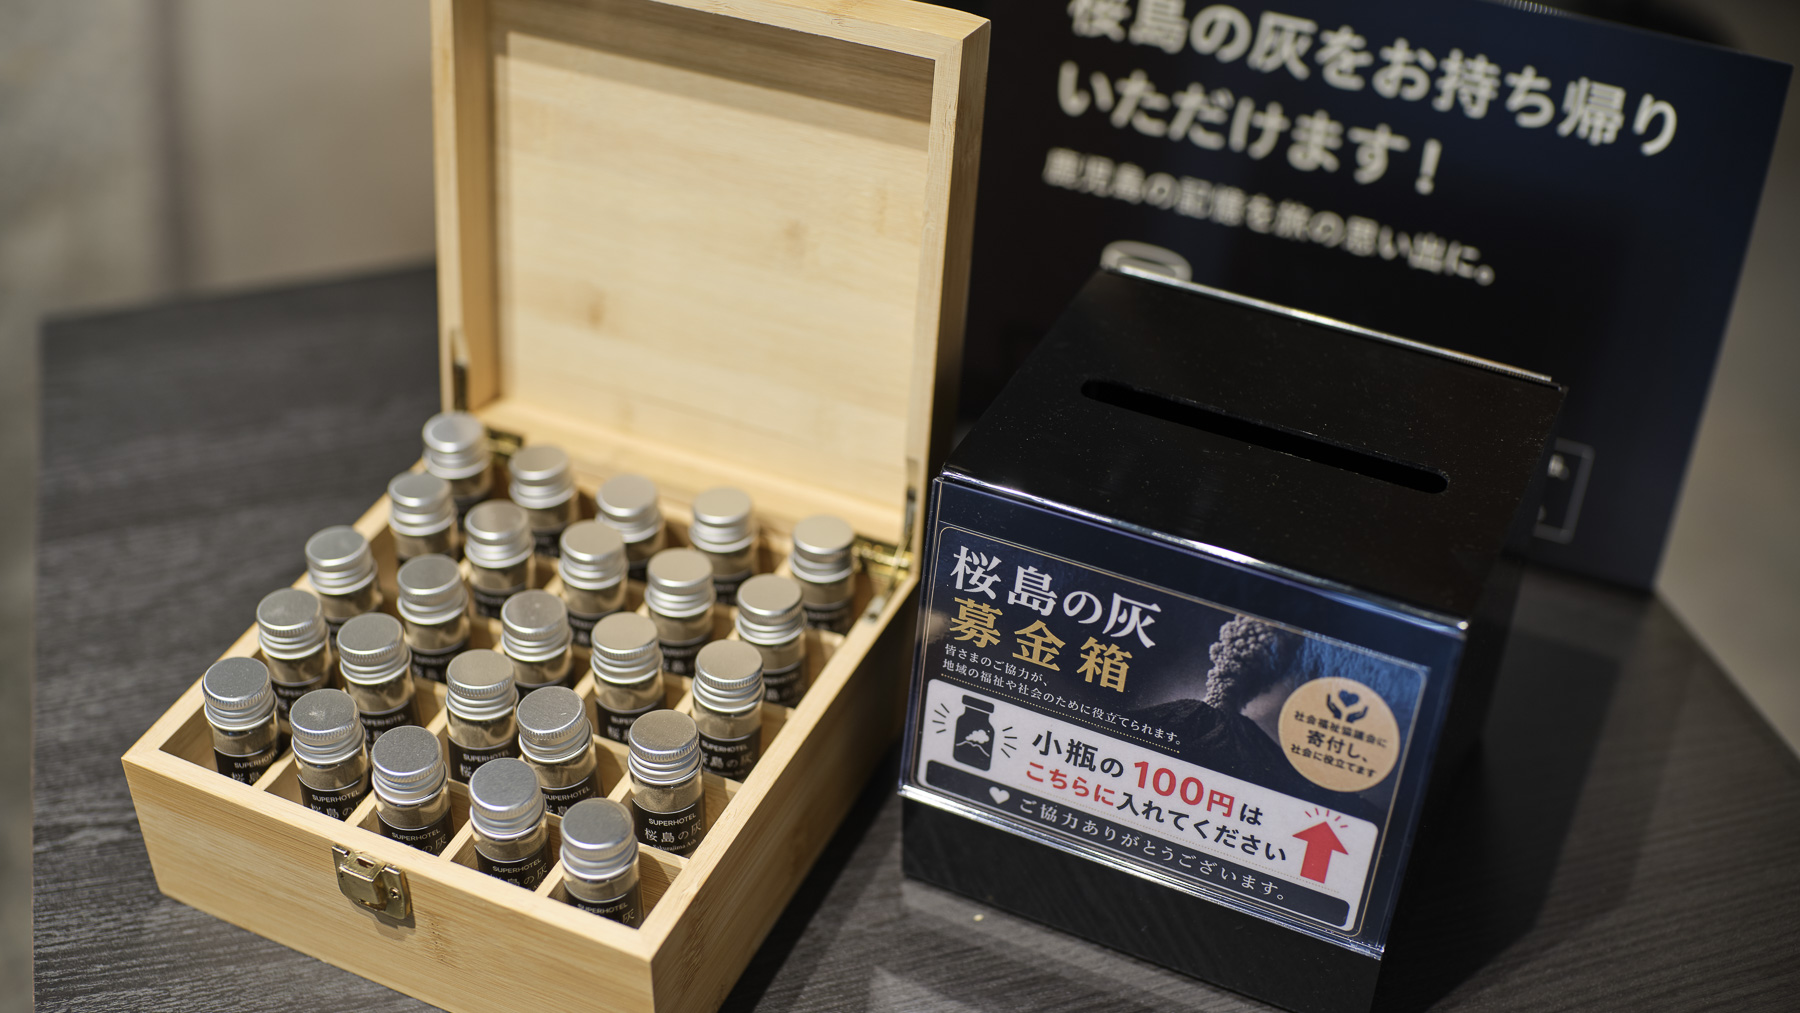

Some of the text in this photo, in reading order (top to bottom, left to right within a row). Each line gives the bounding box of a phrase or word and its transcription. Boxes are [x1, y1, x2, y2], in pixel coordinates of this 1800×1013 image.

[1067, 0, 1677, 156] 桜島の灰をお持ち帰り
[950, 545, 1162, 649] 桜島の灰
[949, 596, 1133, 693] 募金箱
[945, 643, 1049, 687] 皆さまのご協力が、
[942, 658, 1181, 746] 地域の福祉や社会のために役立てられます。
[1294, 710, 1388, 748] 社会福祉協議会に
[1307, 729, 1368, 763] 寄付し、
[1290, 743, 1377, 778] 社会に役立てます
[311, 790, 361, 804] SUPERHOTEL
[1025, 760, 1288, 865] こちらに入れてください
[391, 828, 441, 842] SUPERHOTEL
[644, 819, 702, 844] 桜島の灰
[648, 813, 697, 827] SUPERHOTEL
[492, 858, 542, 874] SUPERHOTEL
[1019, 799, 1287, 901] ご協力ありがとうございます。
